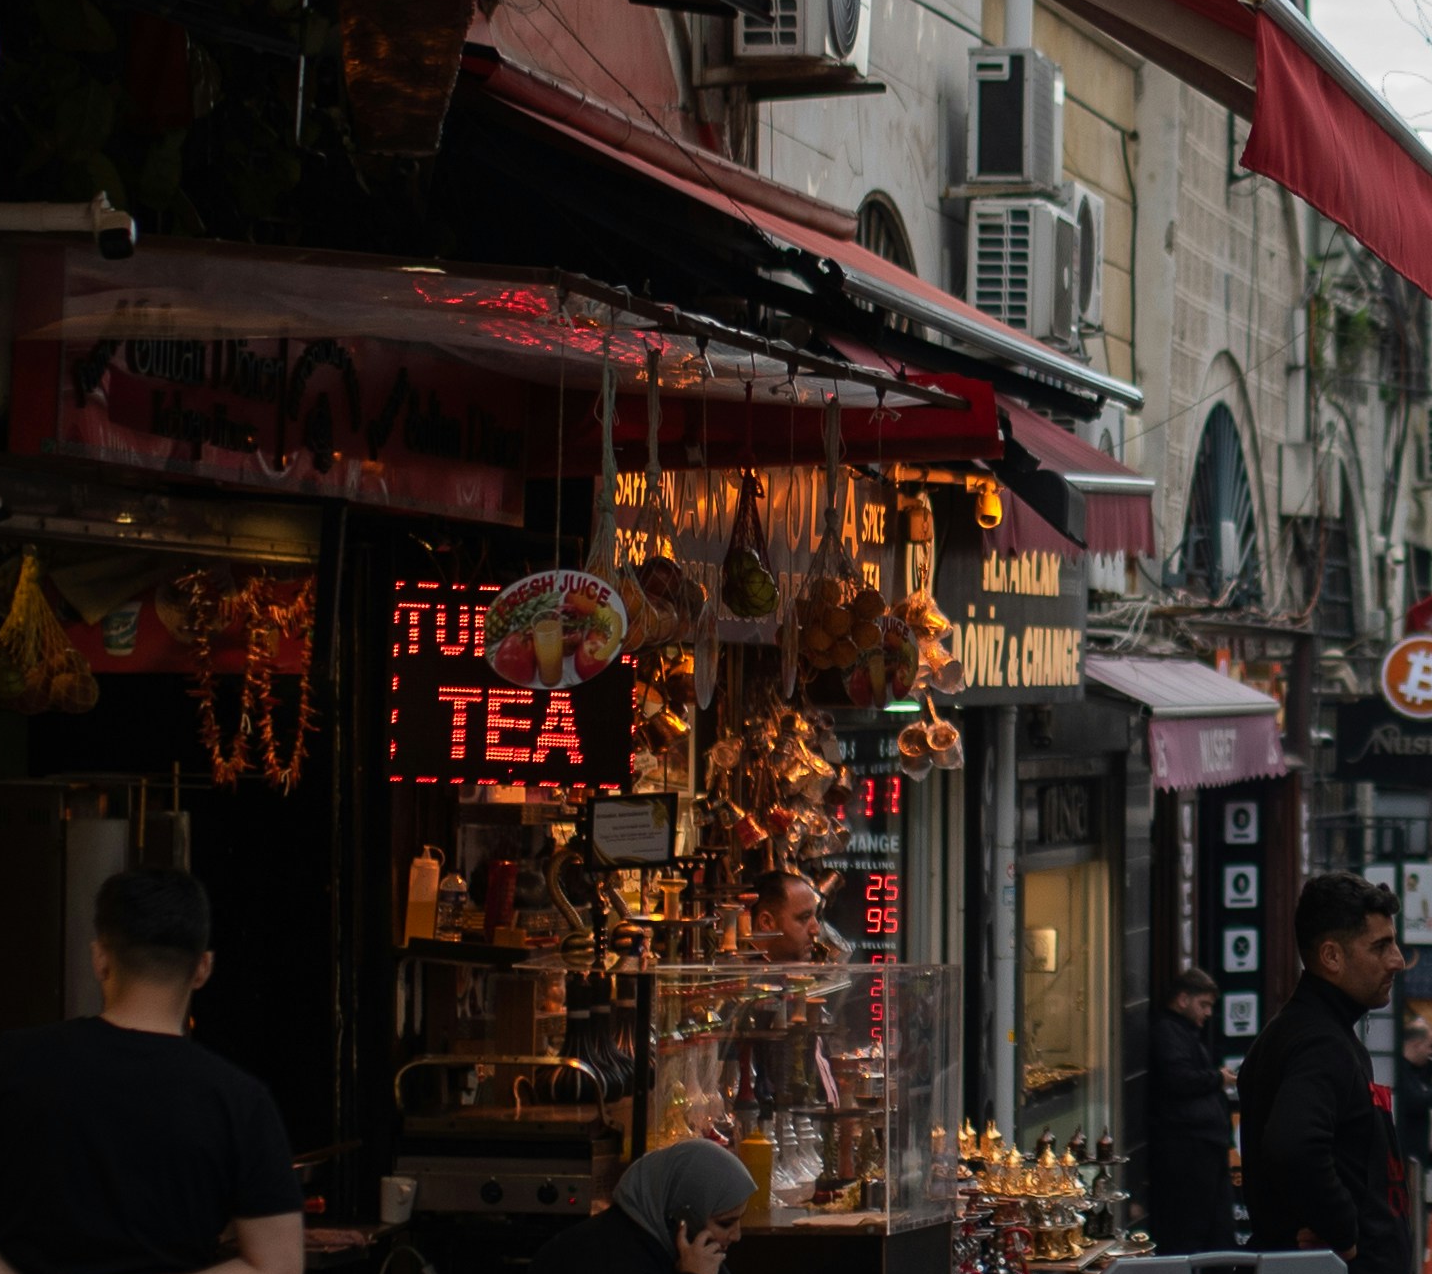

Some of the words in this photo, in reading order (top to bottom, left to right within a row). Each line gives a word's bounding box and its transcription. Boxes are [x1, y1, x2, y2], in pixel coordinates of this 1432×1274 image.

[861, 503, 887, 544] SPICE
[559, 574, 612, 608] JUICE
[1008, 636, 1019, 687] &
[1022, 626, 1083, 687] CHANGE
[436, 686, 584, 765] TEA
[865, 874, 900, 901] 25
[865, 906, 899, 934] 95
